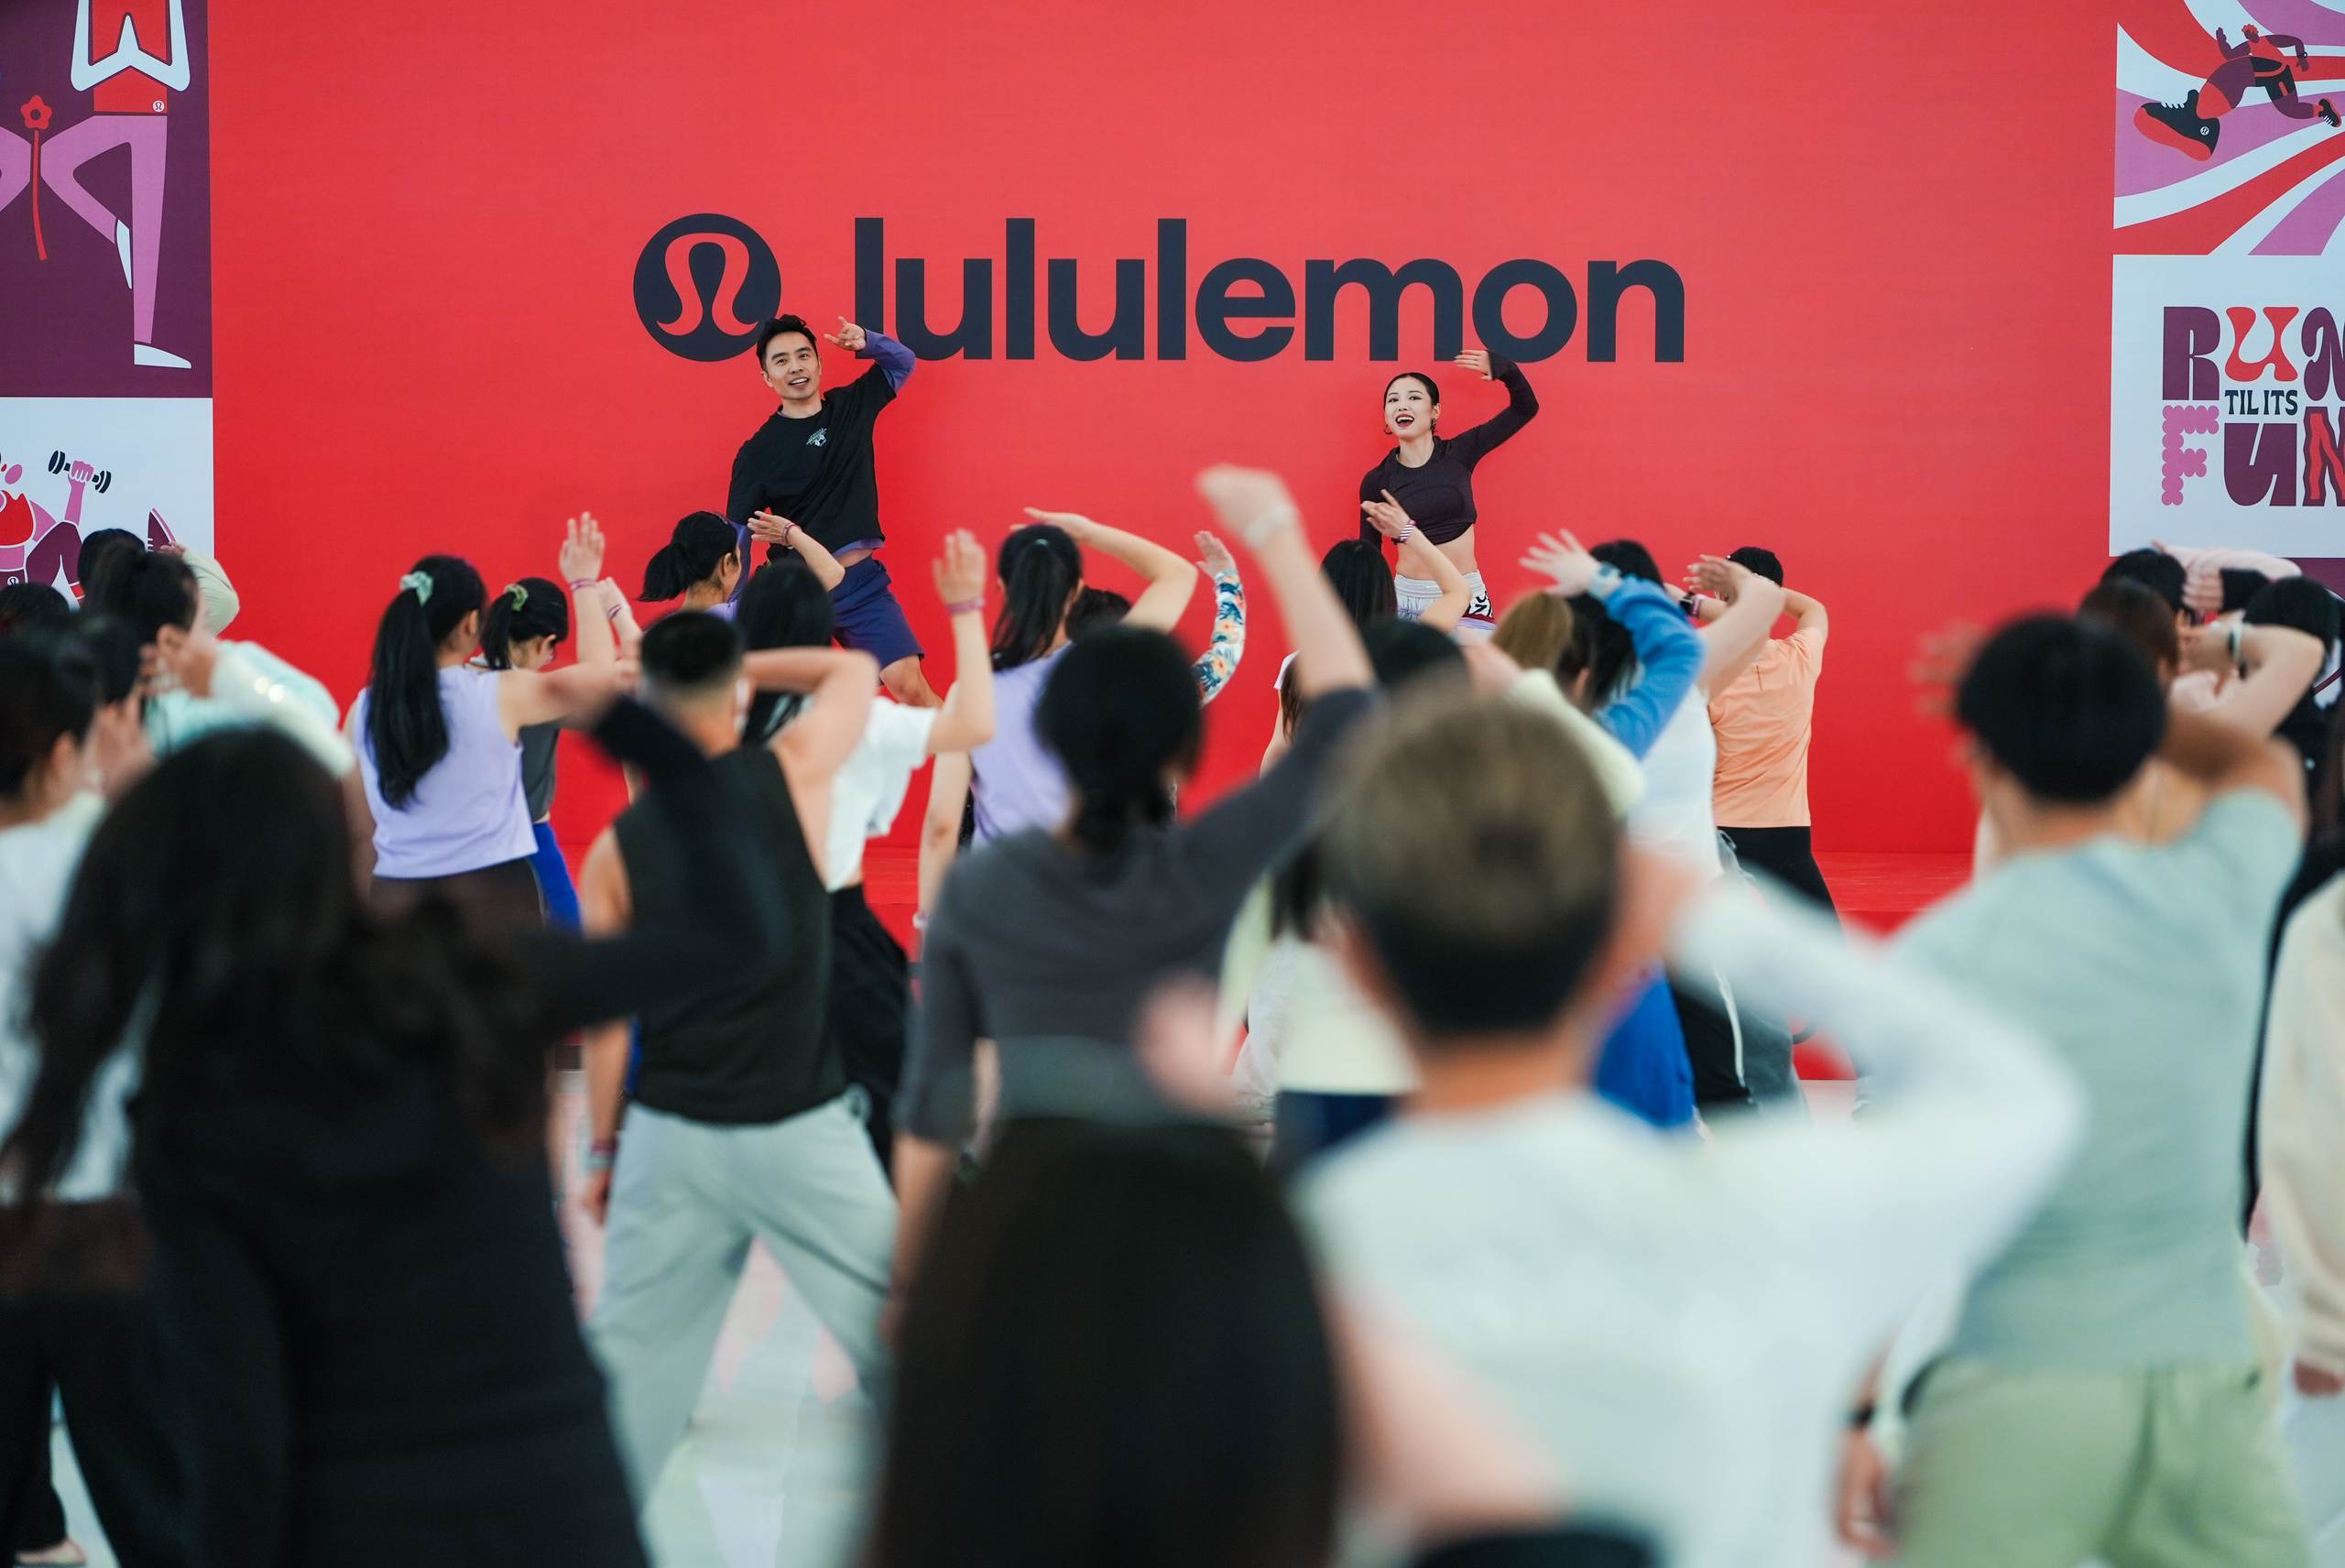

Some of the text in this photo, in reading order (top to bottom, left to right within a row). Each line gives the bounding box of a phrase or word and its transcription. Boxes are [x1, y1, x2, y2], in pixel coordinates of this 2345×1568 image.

[855, 217, 1685, 363] lululemon
[2224, 389, 2298, 416] TIL ITS
